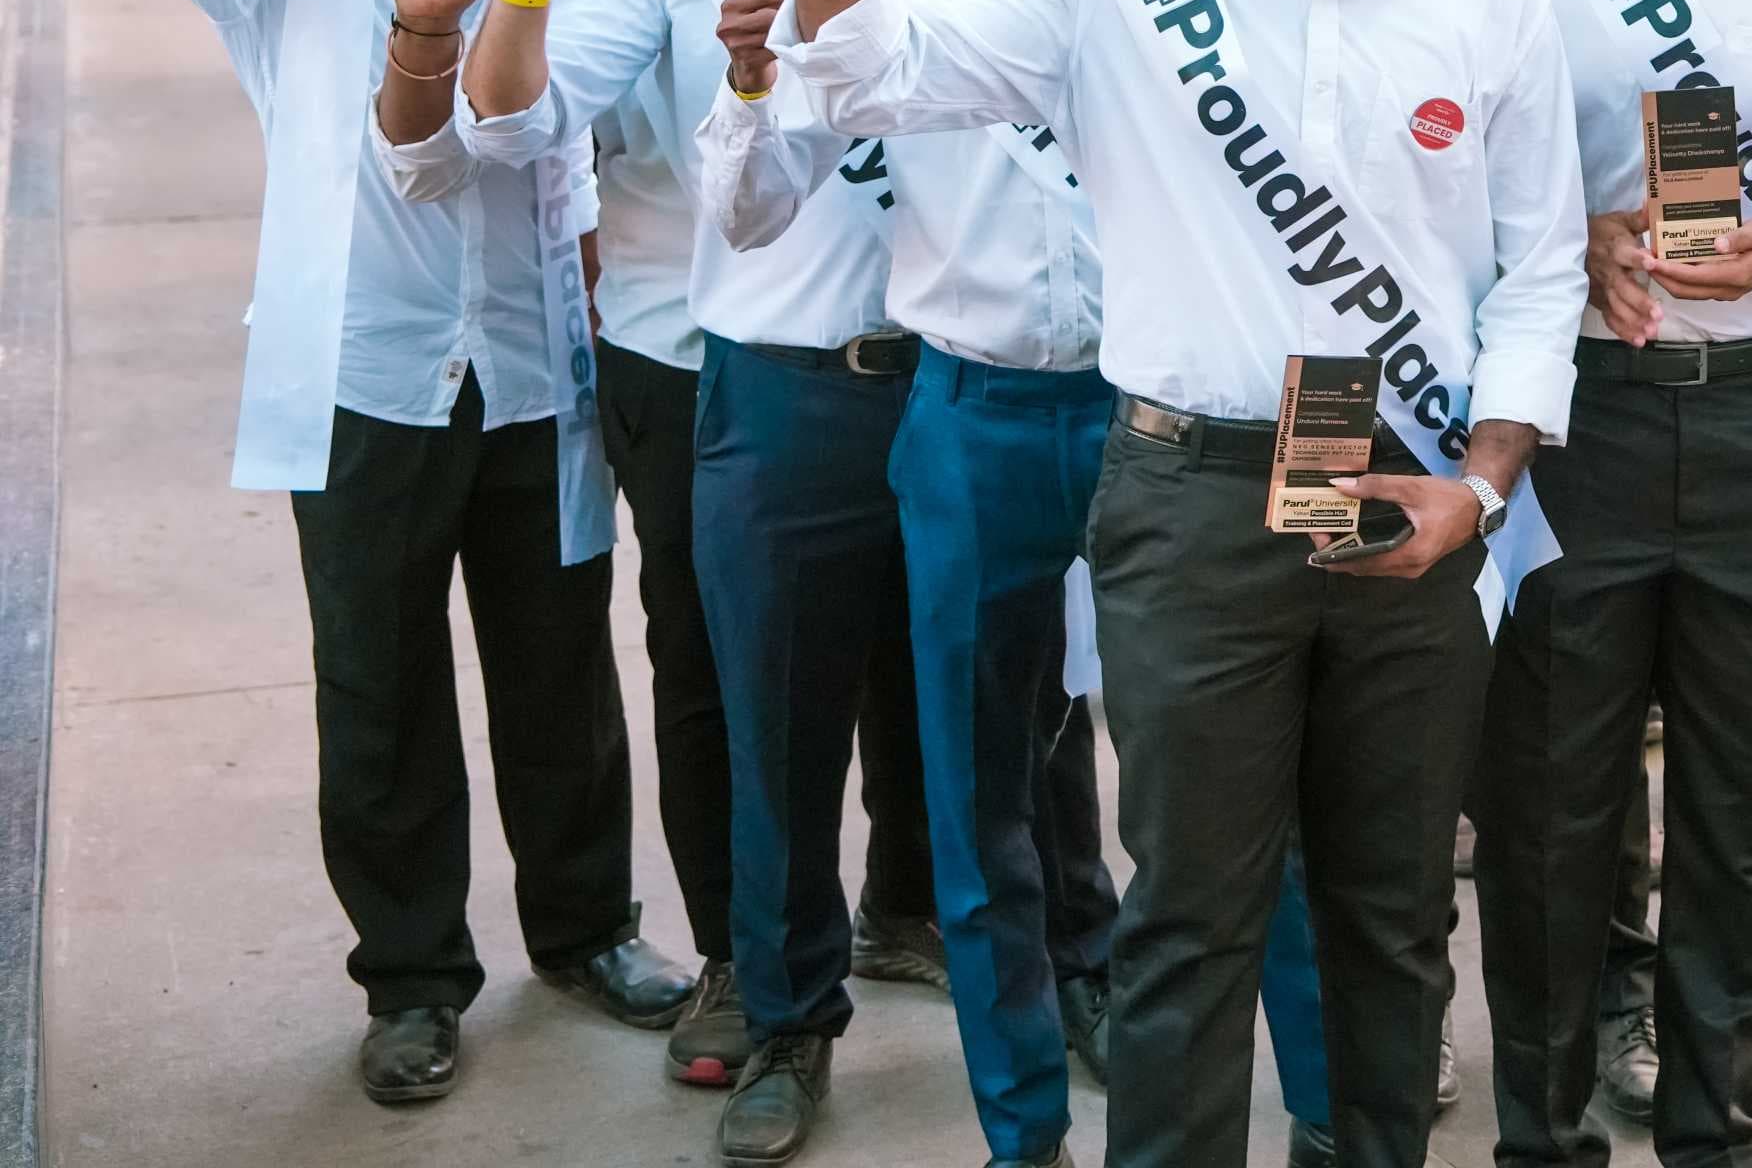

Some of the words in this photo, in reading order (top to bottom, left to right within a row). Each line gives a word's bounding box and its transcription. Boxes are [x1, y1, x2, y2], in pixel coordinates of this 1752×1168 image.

[1416, 121, 1453, 139] PLACED
[1647, 122, 1658, 198] #PUPlacement
[1277, 385, 1295, 463] #PUPlacement
[1315, 498, 1358, 508] University
